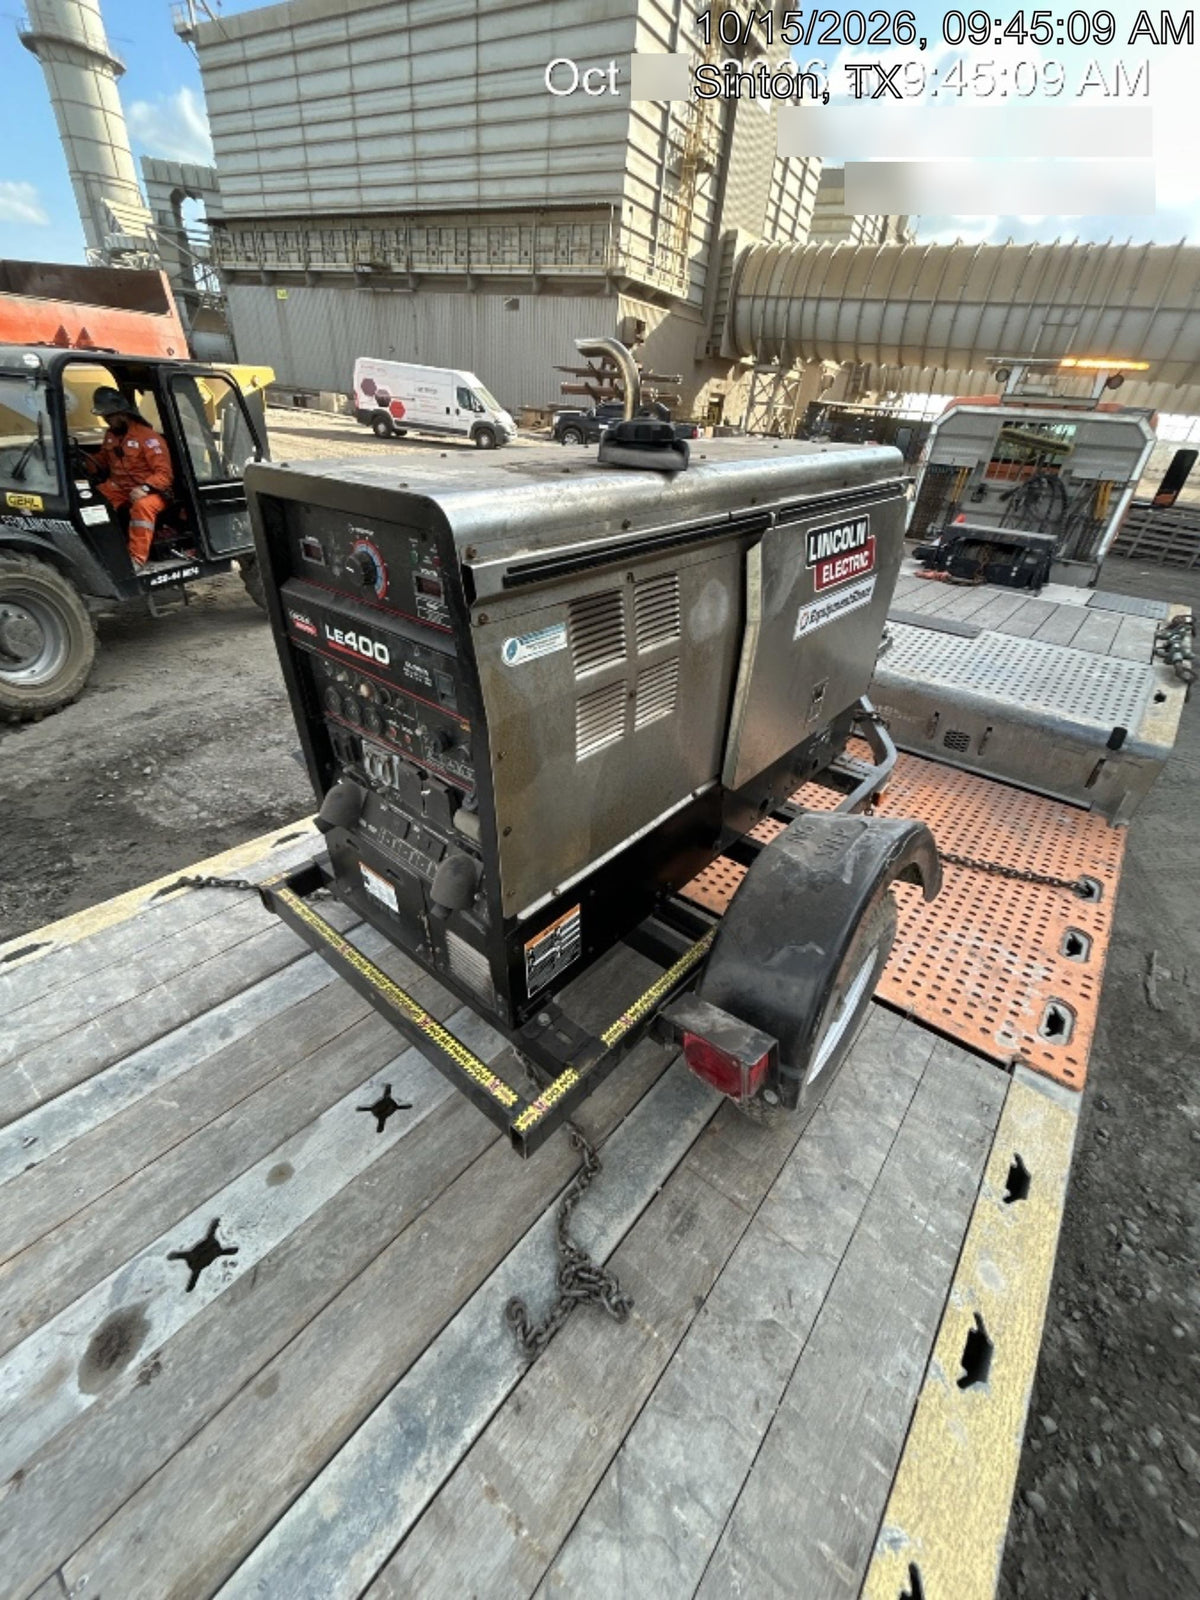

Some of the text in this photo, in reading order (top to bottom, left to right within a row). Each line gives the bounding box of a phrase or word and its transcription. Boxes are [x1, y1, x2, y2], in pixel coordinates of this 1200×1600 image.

[809, 521, 867, 562] LINCOLN
[822, 550, 870, 584] ELECTRIC
[325, 623, 390, 665] LE400
